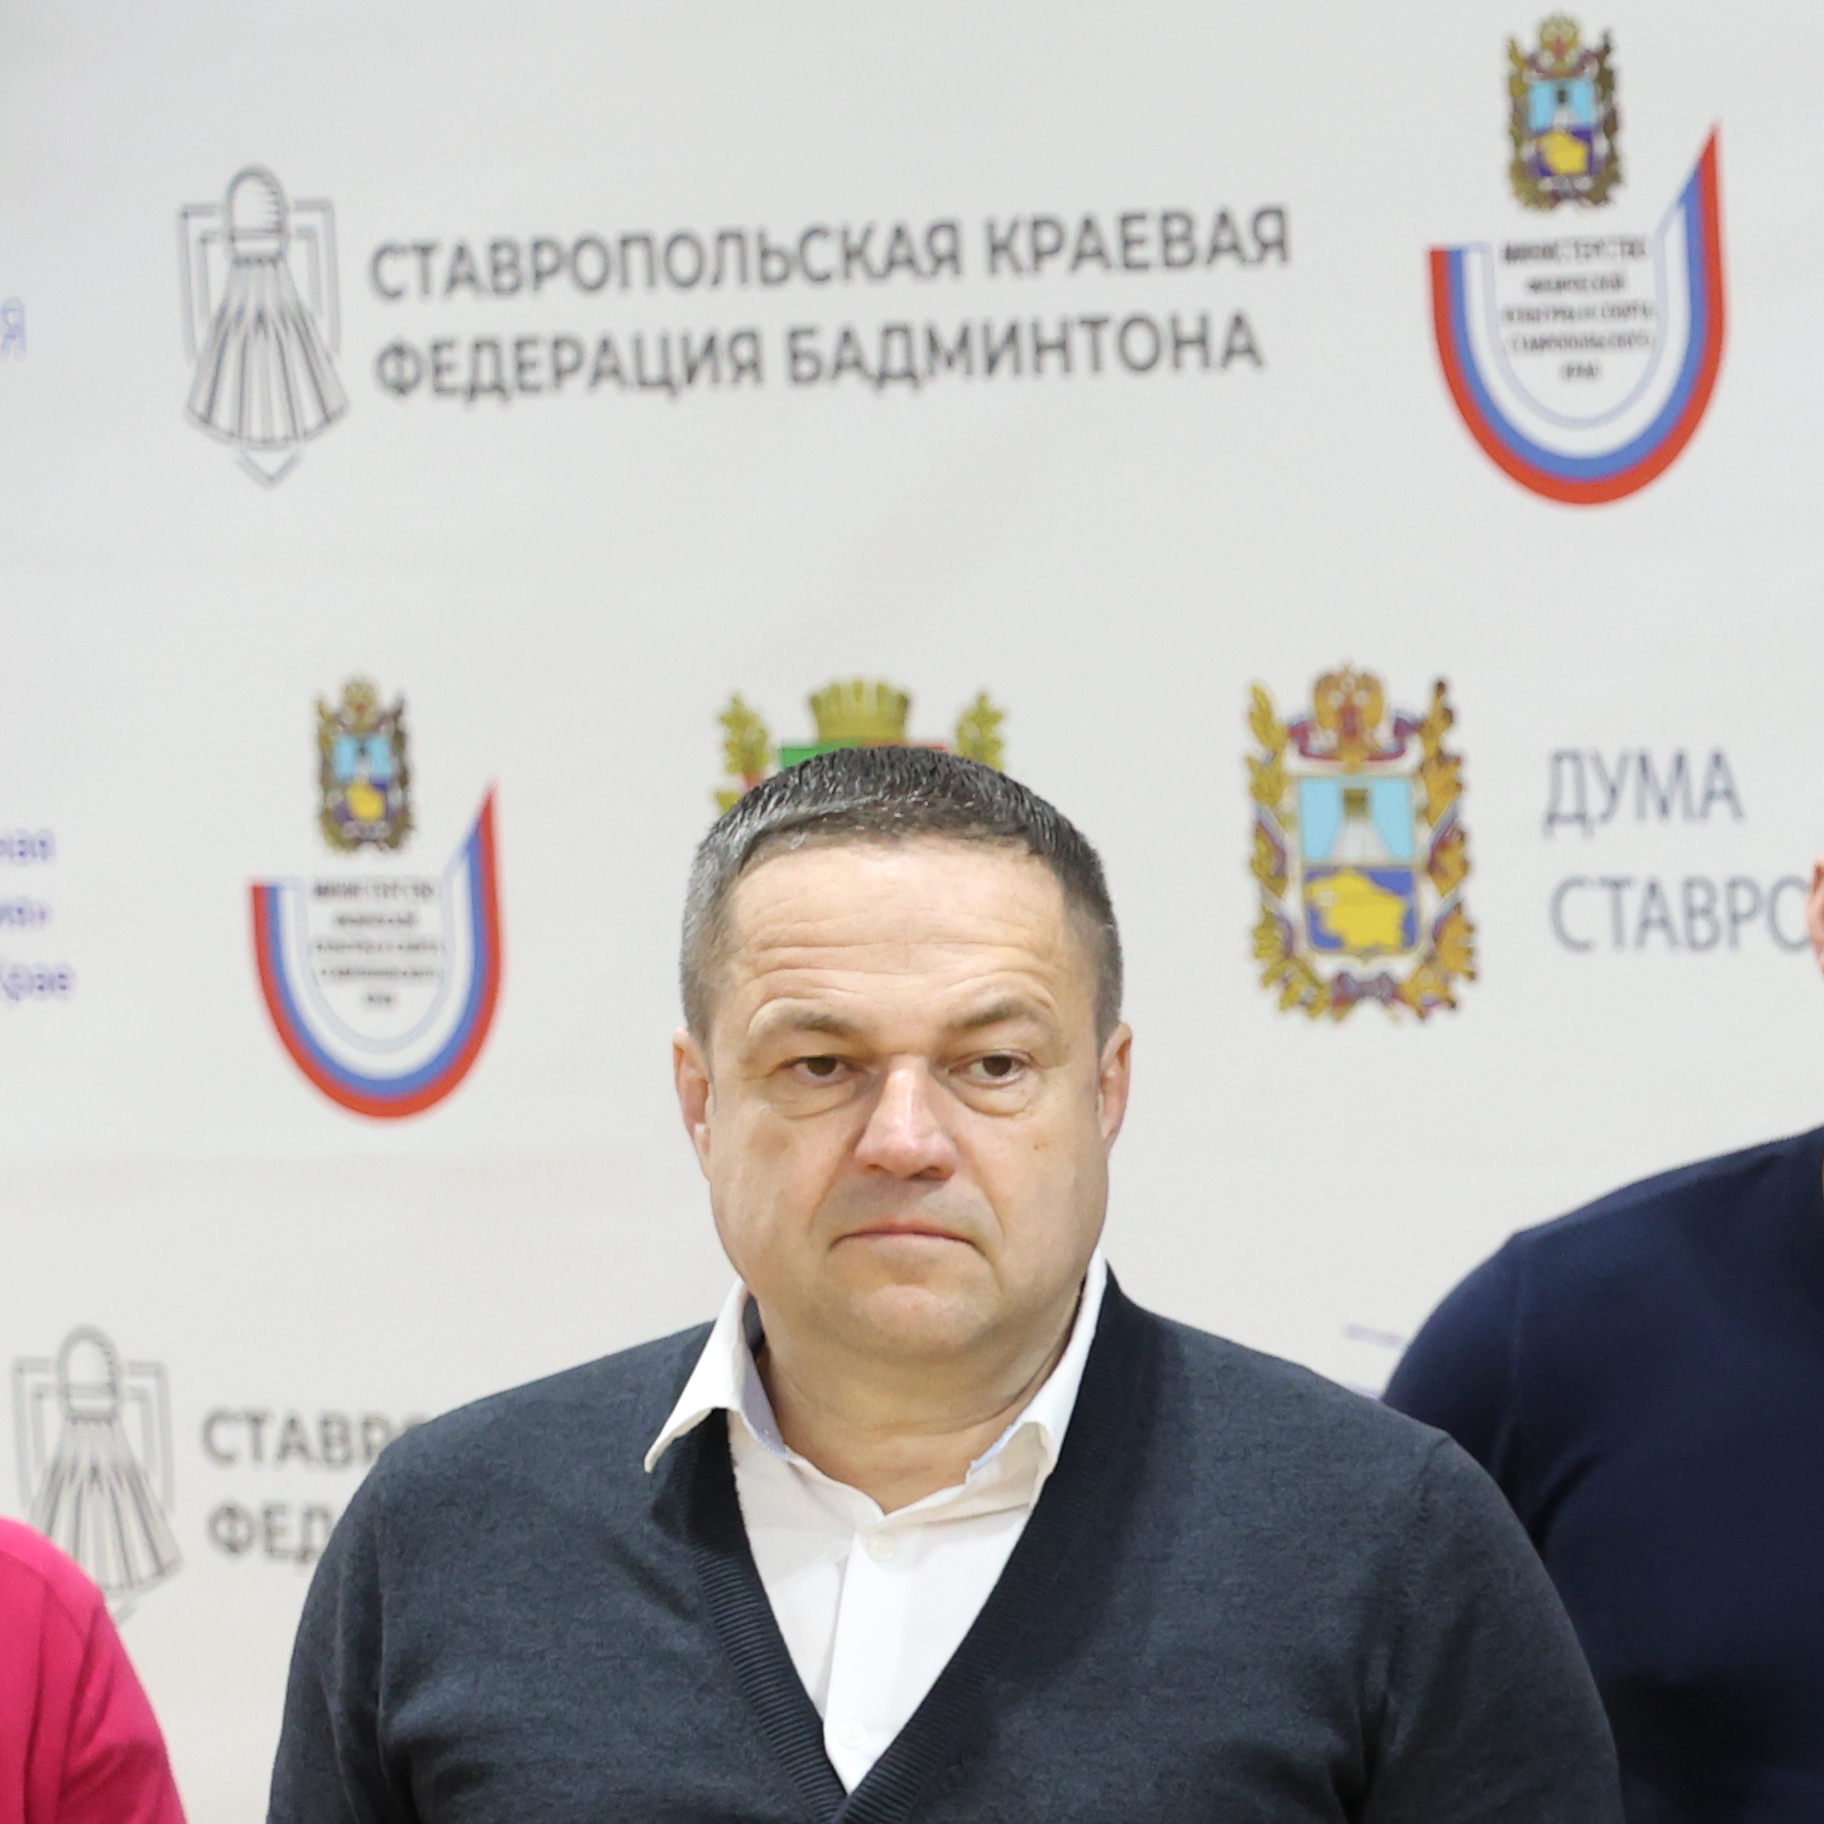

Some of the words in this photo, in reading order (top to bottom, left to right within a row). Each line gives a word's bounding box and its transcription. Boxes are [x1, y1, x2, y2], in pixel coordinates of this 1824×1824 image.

[368, 220, 963, 300] СТАВРОПОЛЬСКАЯ
[985, 203, 1292, 275] КРАЕВАЯ
[374, 325, 763, 407] ФЕДЕРАЦИЯ
[784, 308, 1268, 396] БАДМИНТОНА
[1541, 747, 1746, 840] ДУМА
[203, 1405, 432, 1470] СТАВР
